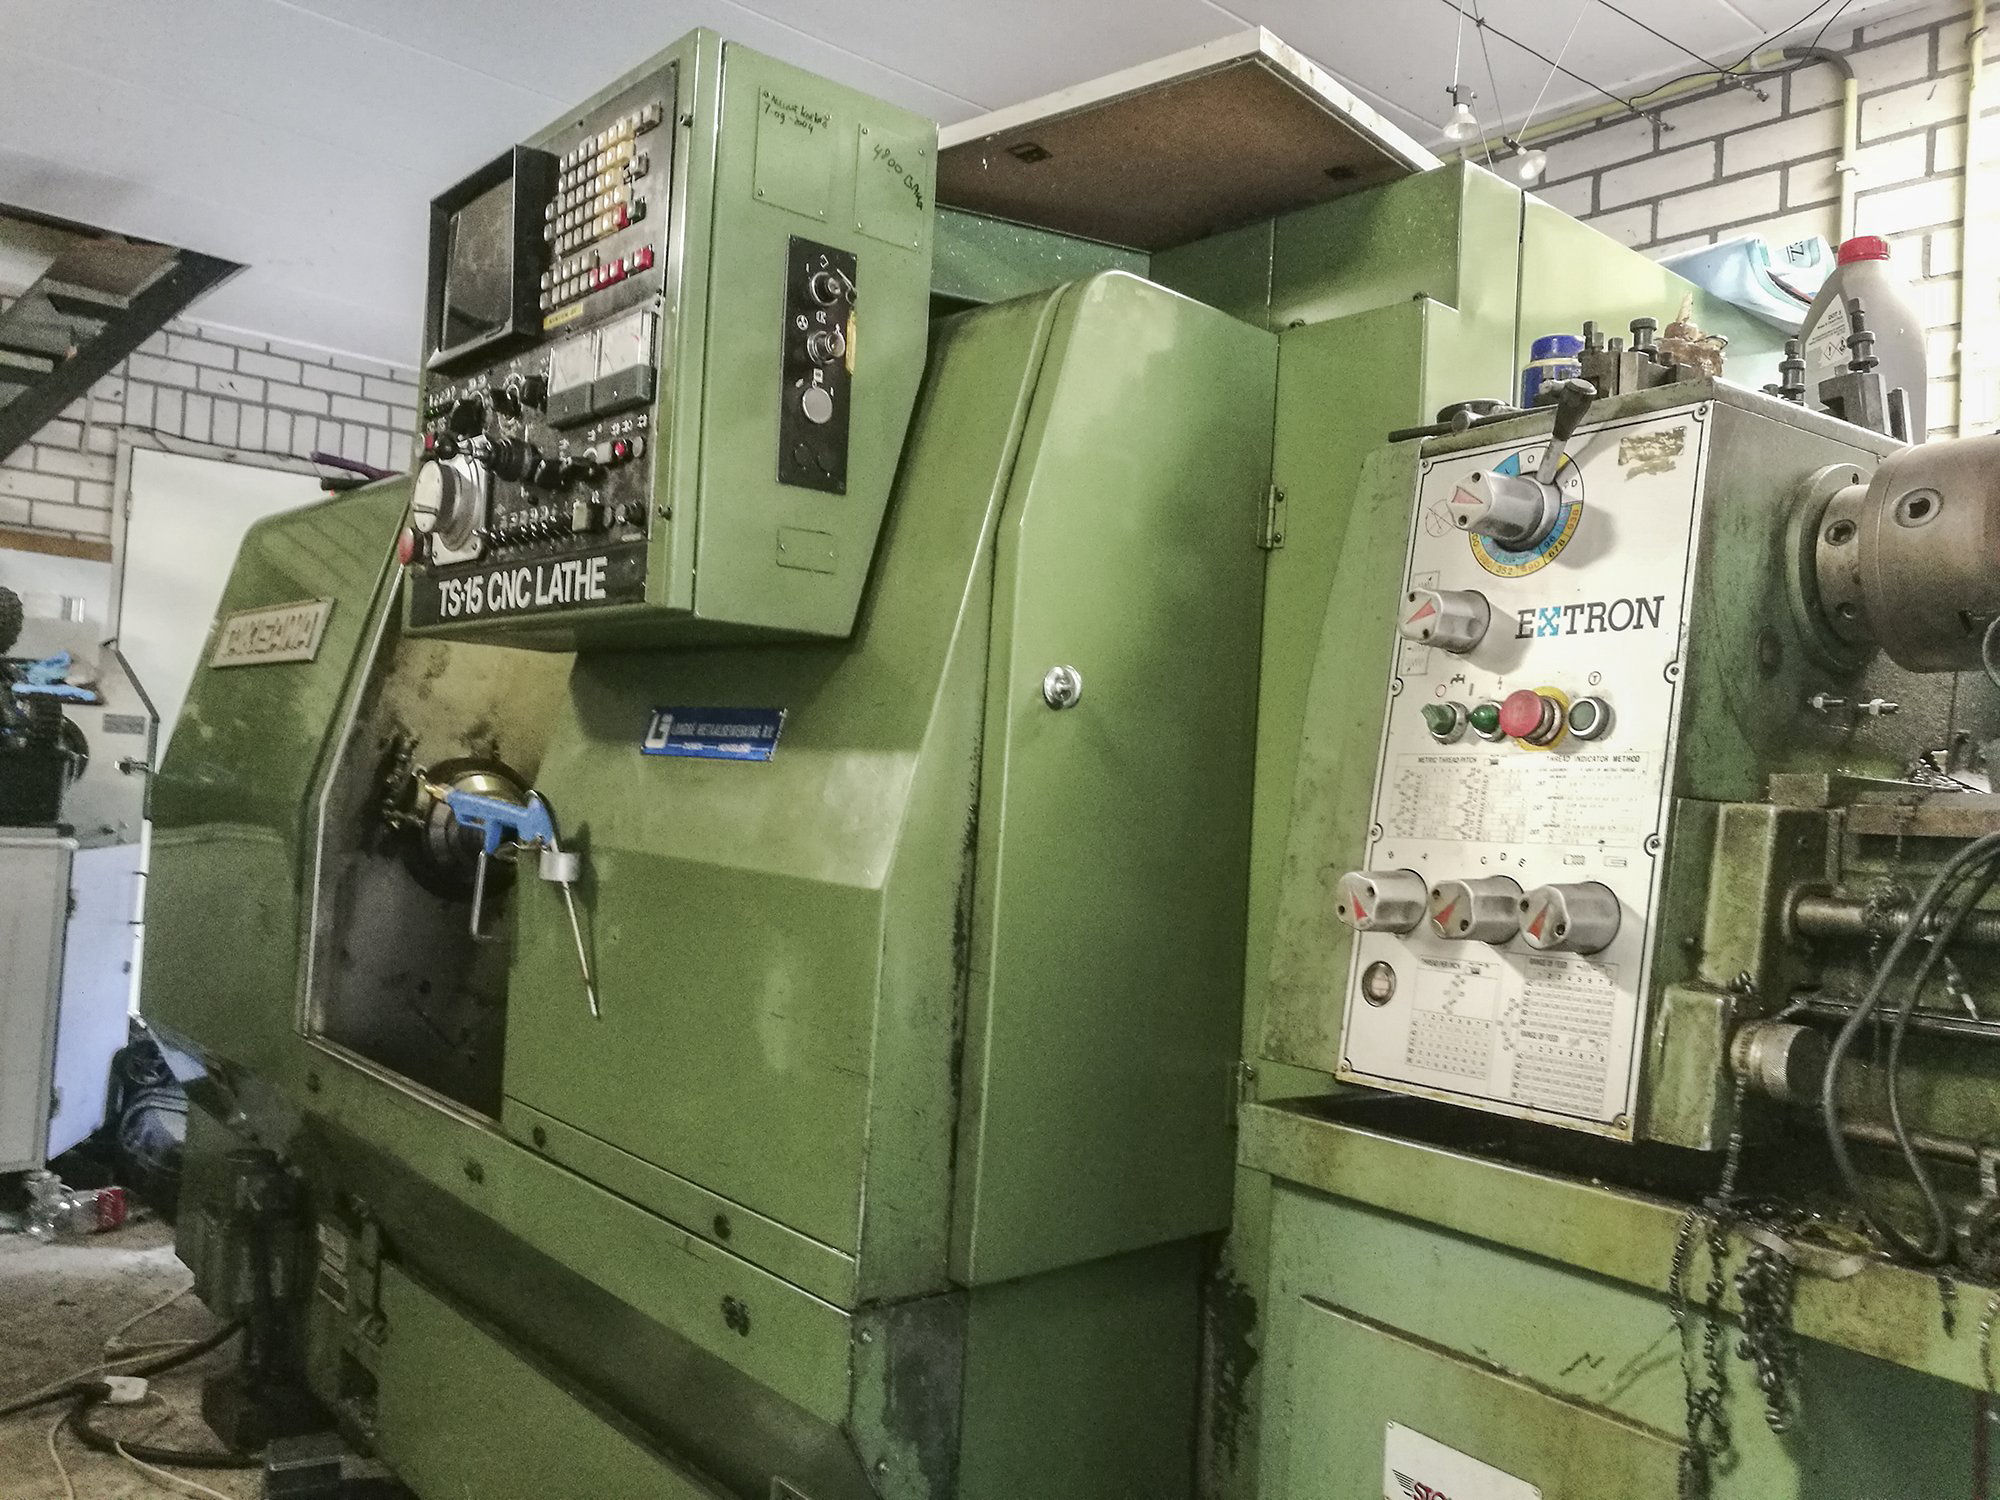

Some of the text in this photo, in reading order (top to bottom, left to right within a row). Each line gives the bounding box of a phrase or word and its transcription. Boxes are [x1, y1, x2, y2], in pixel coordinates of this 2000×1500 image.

[873, 144, 903, 174] 4800
[439, 556, 608, 617] TS-15 CNC LATHE
[1515, 595, 1665, 639] EXTRON
[1575, 755, 1609, 763] INDICATOR
[1612, 755, 1641, 763] METHOD
[1518, 857, 1526, 868] E
